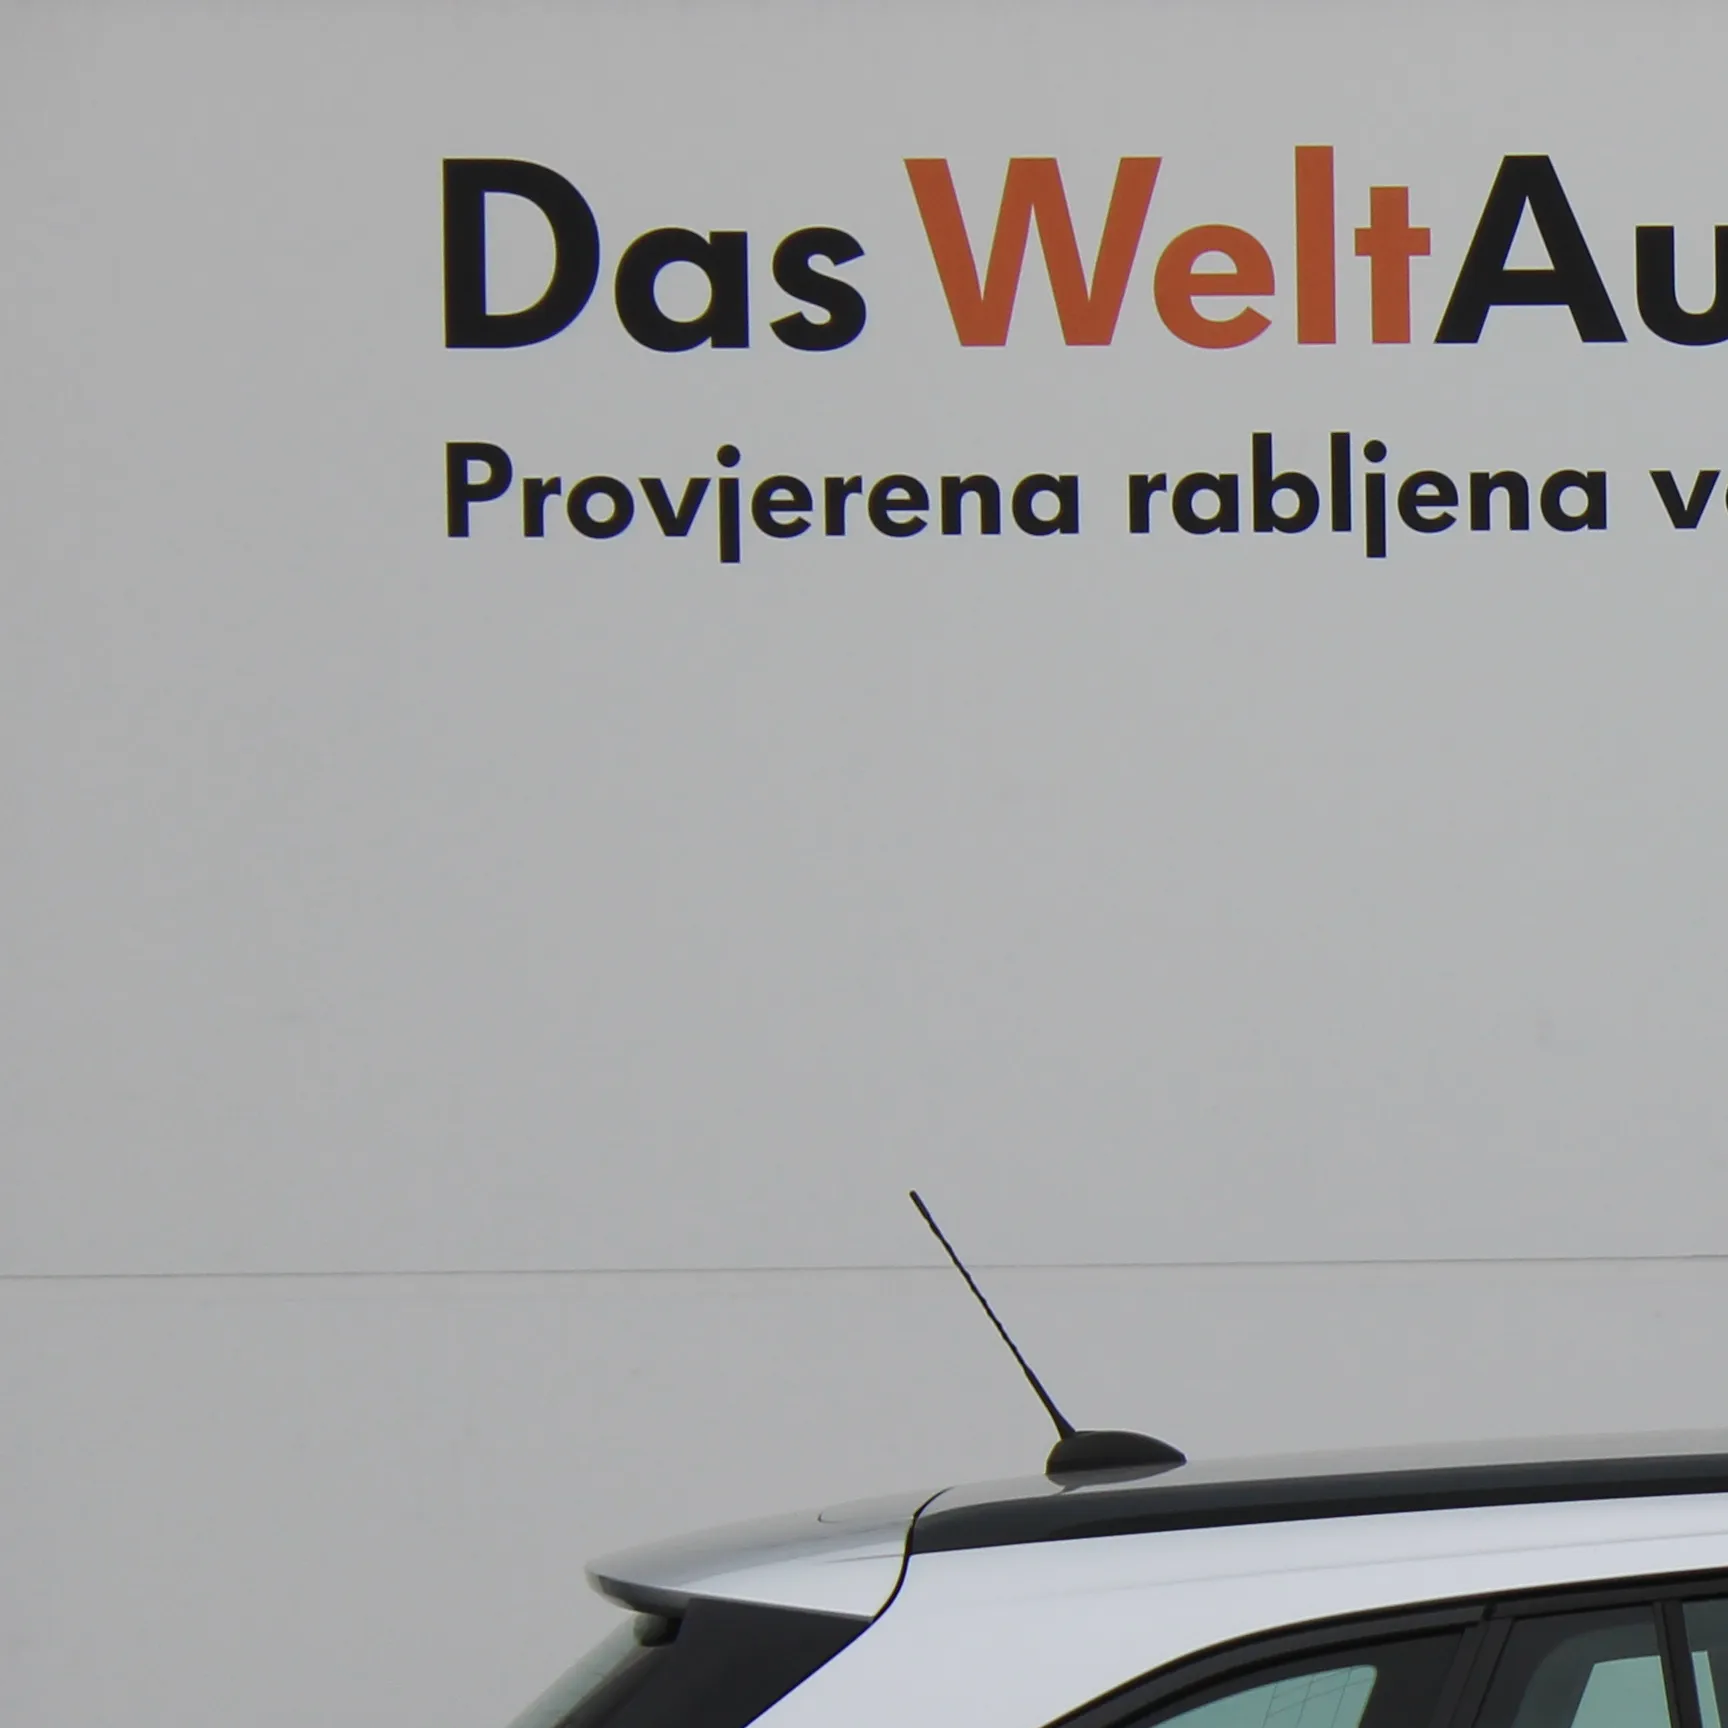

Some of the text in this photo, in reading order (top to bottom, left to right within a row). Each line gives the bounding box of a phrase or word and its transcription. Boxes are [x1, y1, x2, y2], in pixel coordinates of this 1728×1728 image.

[441, 156, 867, 353] Das
[445, 441, 1081, 564] Provjerena
[1128, 431, 1608, 559] rabljena
